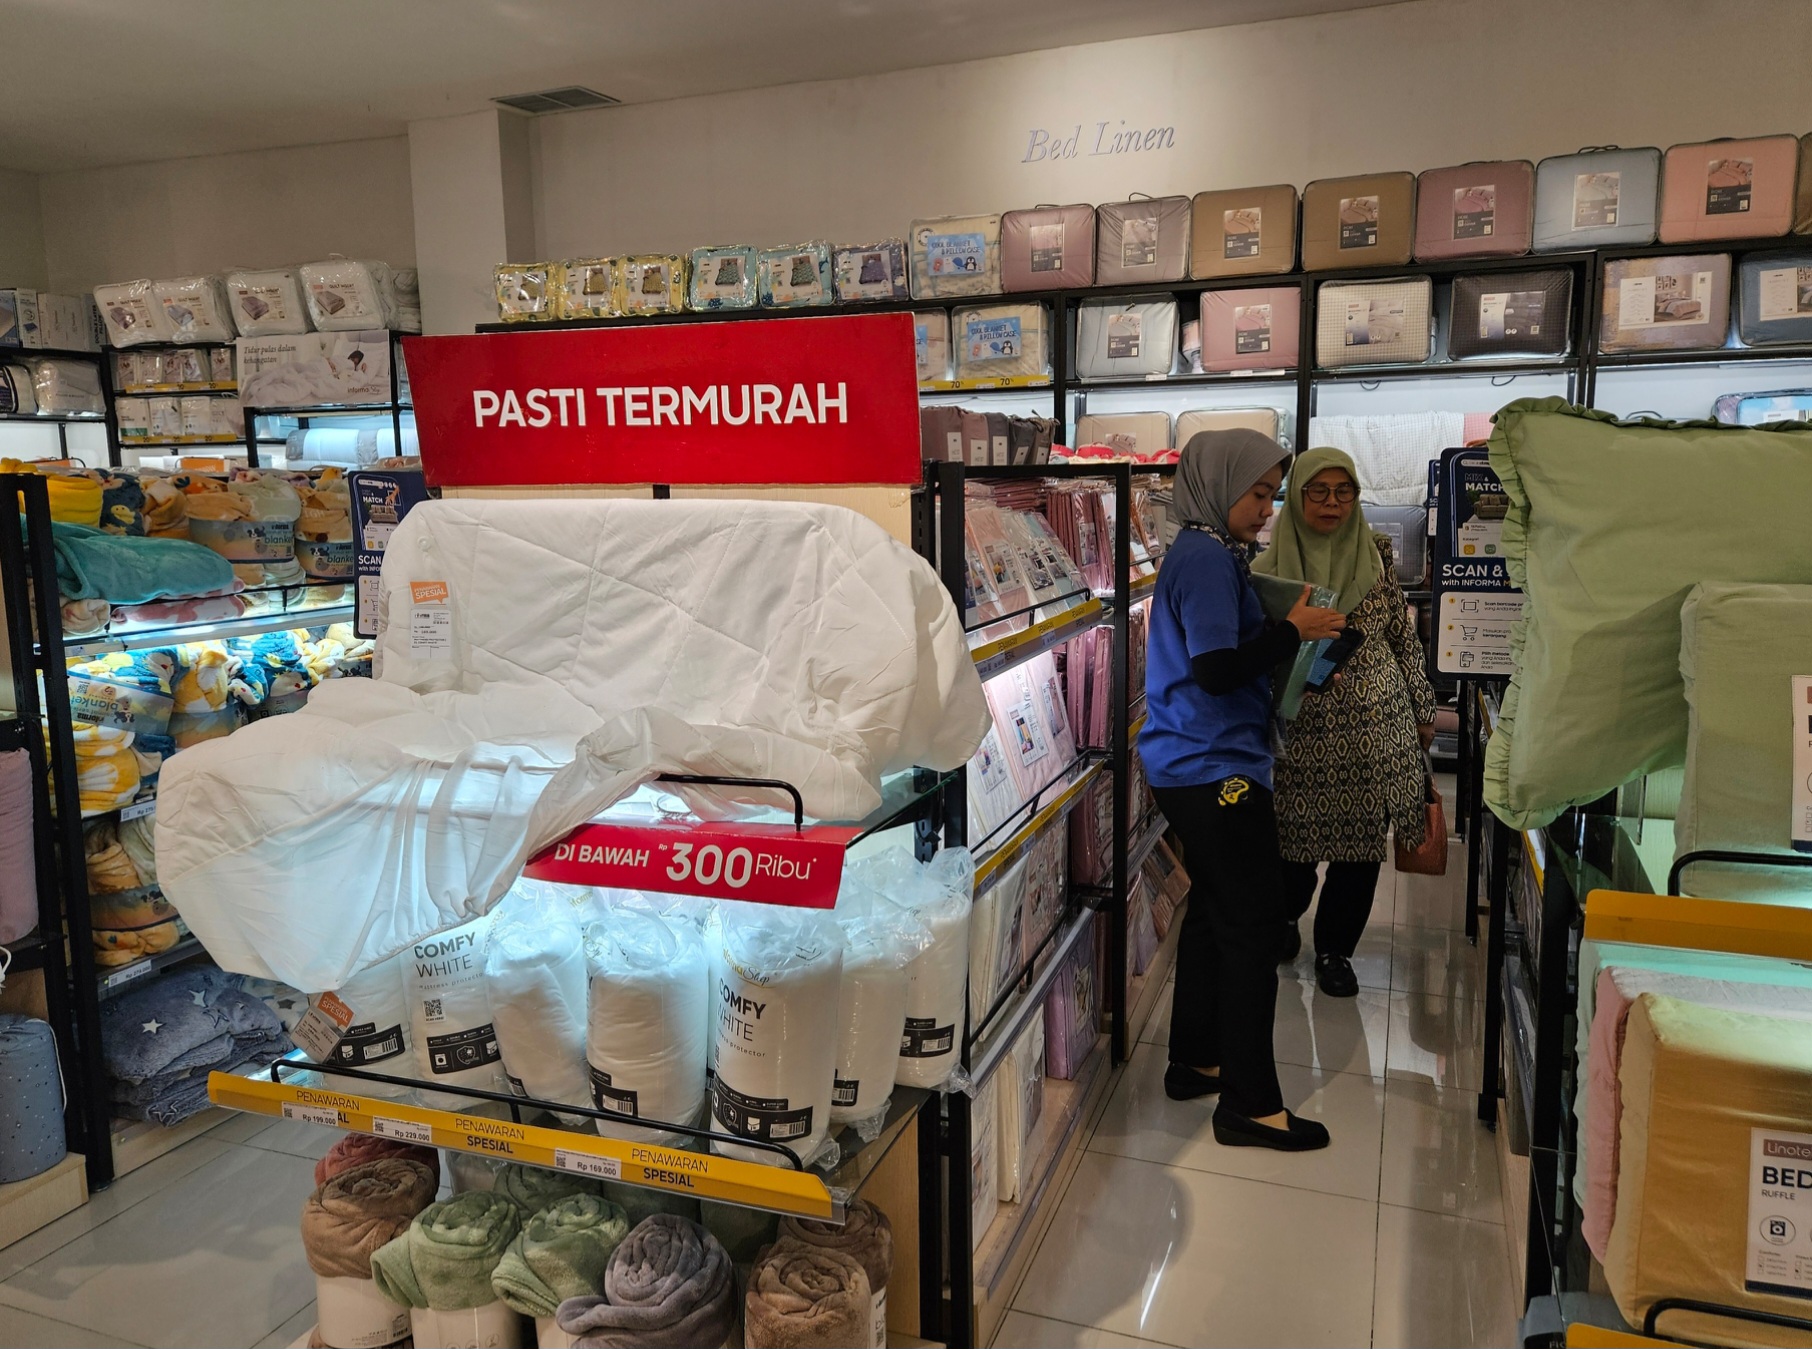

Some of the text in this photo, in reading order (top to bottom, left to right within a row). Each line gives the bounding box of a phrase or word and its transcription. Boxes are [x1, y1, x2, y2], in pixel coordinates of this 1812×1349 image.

[1021, 120, 1175, 164] Bed Linen
[967, 246, 981, 254] CASE
[1004, 330, 1017, 338] CASE
[244, 344, 297, 355] Tidur pulas dalam
[473, 382, 848, 428] PASTI TERMURAH
[362, 495, 383, 504] MATCH
[264, 535, 293, 544] blanke
[358, 555, 382, 565] SCAN
[1442, 563, 1504, 577] SCAN &
[1461, 579, 1502, 587] INFORMA
[415, 587, 447, 600] SPESIAL
[71, 696, 119, 712] blanket
[554, 843, 572, 861] DI
[578, 845, 649, 868] BAWAH
[658, 843, 668, 851] Rp
[666, 842, 753, 888] 300
[413, 931, 476, 960] COMFY
[416, 953, 473, 978] WHITE
[451, 972, 484, 987] protecto
[719, 977, 767, 1020] COMFY
[321, 1000, 349, 1022] SPESIAL
[729, 1042, 766, 1058] protector
[296, 1090, 360, 1111] PENAWARAN
[302, 1114, 312, 1122] Rp
[312, 1115, 337, 1126] 199.000
[394, 1129, 430, 1141] Rp 229.000
[455, 1118, 525, 1141] PENAWARAN
[467, 1135, 514, 1154] SPESIAL
[1767, 1141, 1812, 1158] Linote
[577, 1161, 588, 1171] Rp
[589, 1164, 617, 1176] 169.000
[631, 1148, 709, 1174] PENAWARAN
[643, 1167, 695, 1188] SPESIAL
[1761, 1189, 1796, 1201] RUFFLE
